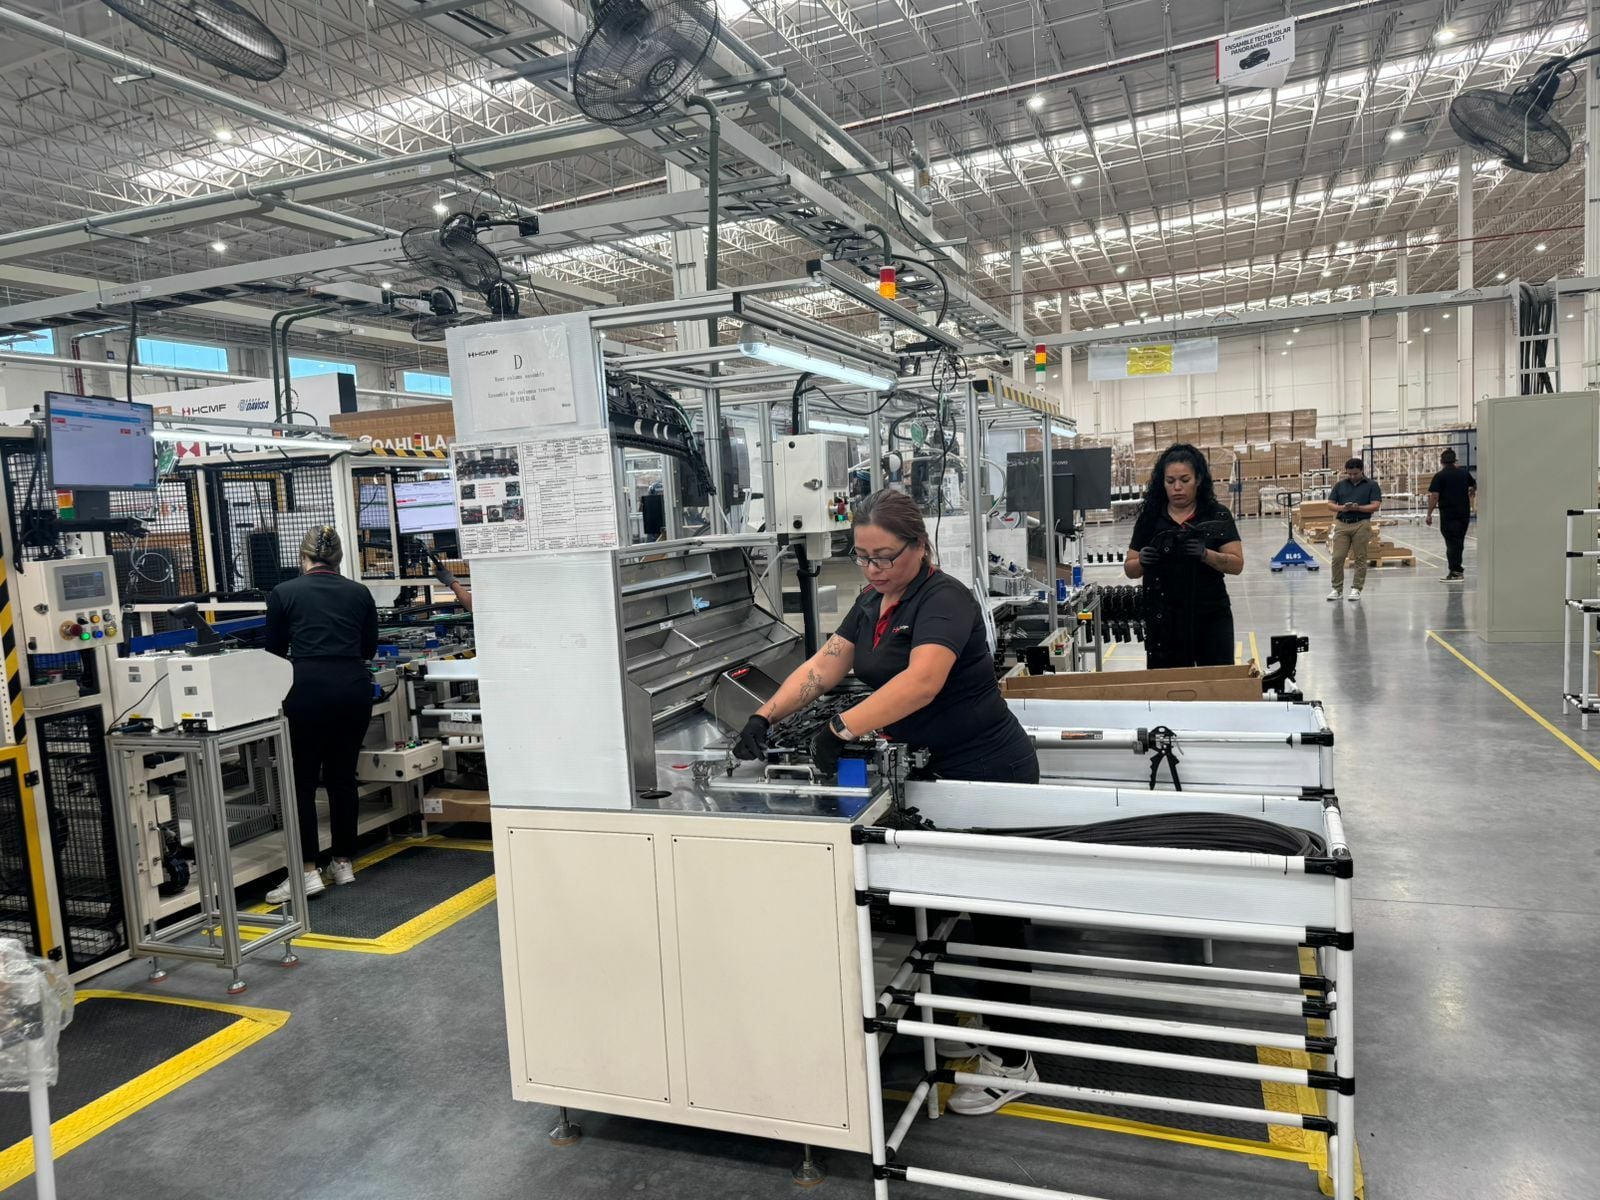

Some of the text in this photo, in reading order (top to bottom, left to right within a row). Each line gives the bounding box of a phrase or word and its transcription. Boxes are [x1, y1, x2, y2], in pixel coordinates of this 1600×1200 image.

[1225, 39, 1254, 51] ENSAMBLE
[1254, 32, 1272, 43] TECHO
[1272, 26, 1291, 37] SOLAR
[513, 354, 523, 370] D
[192, 403, 227, 414] HCMF
[246, 400, 270, 412] DAVISA
